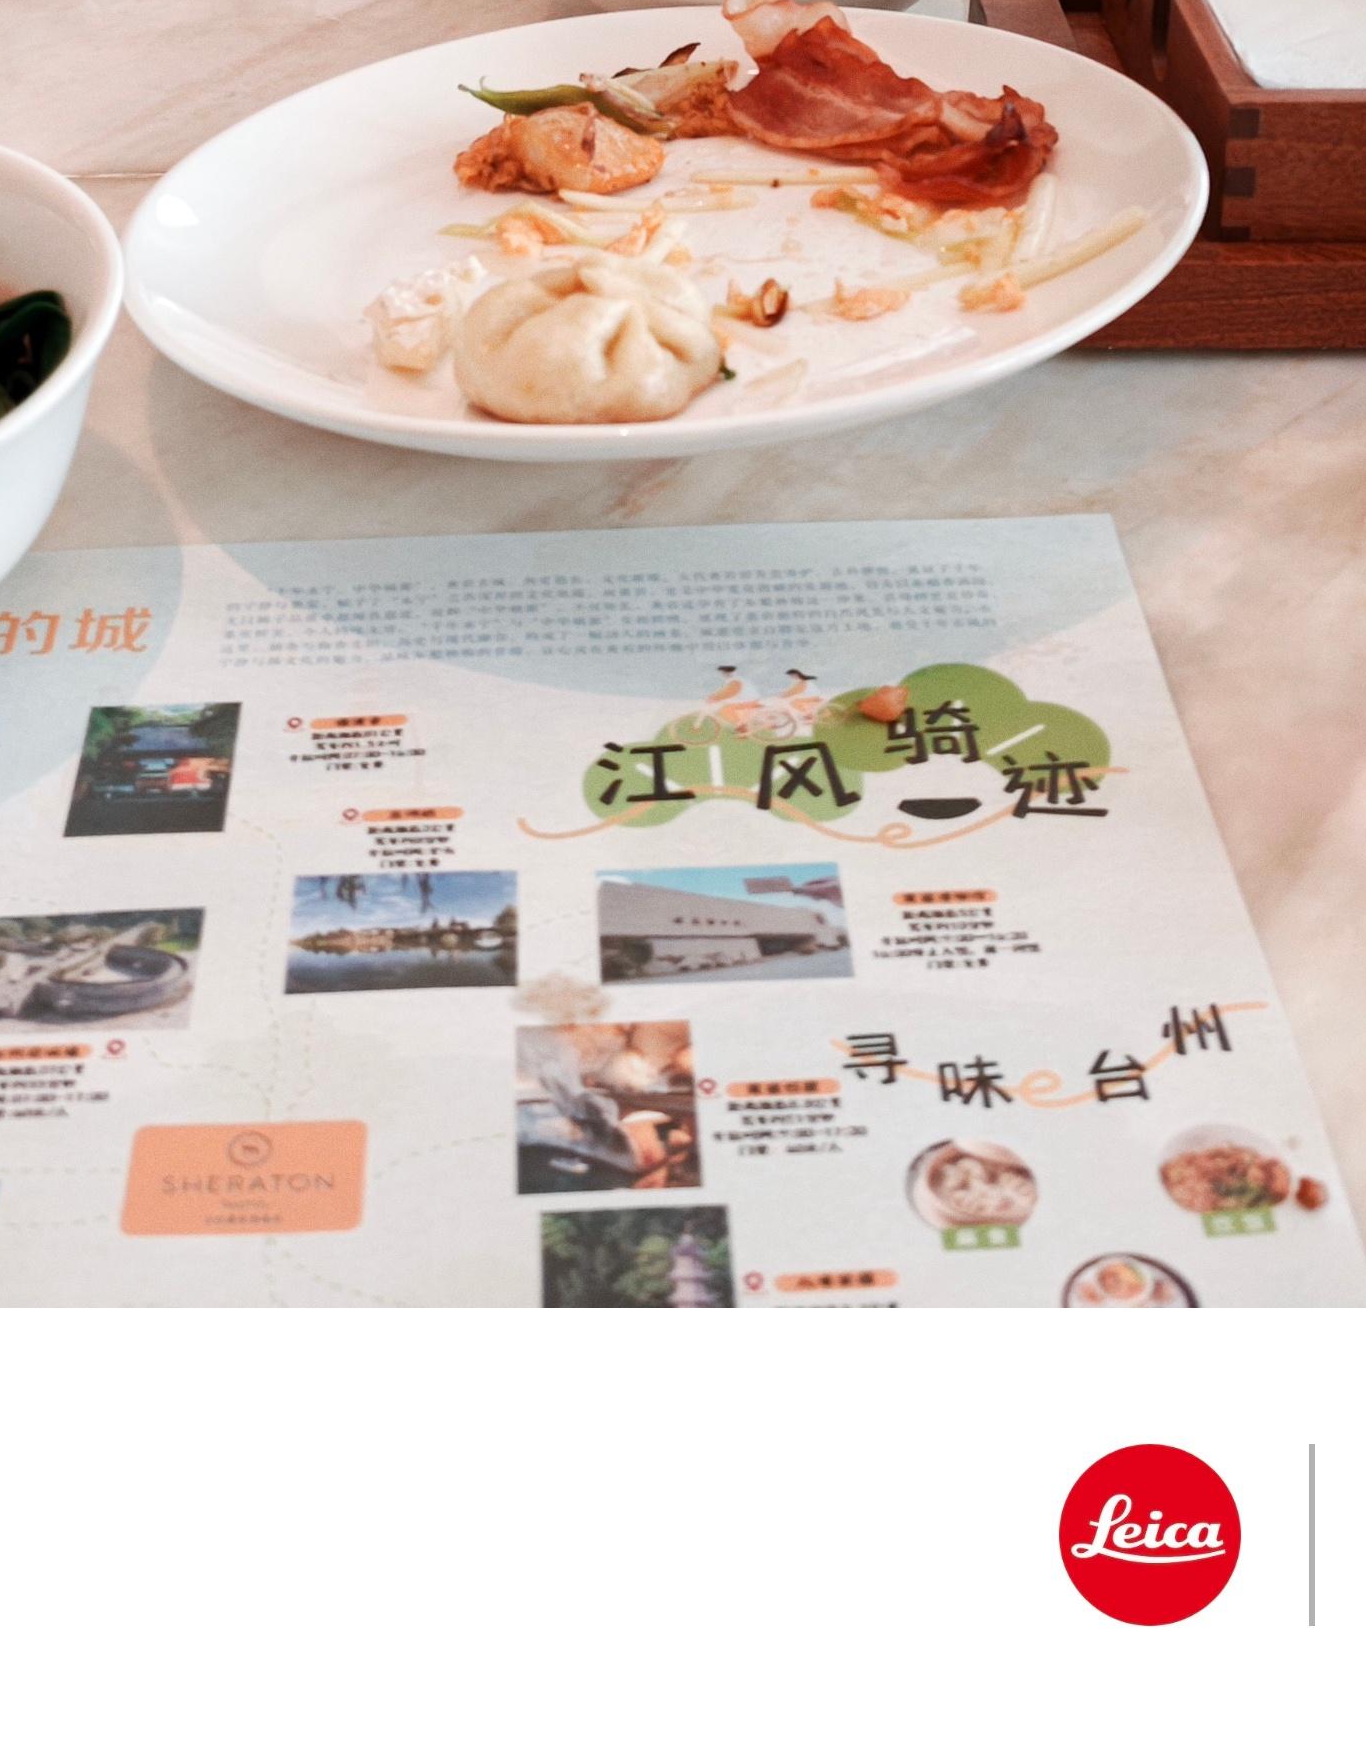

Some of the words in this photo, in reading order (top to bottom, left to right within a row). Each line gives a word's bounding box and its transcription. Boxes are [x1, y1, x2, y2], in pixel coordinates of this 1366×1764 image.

[597, 699, 1110, 819] 江风骑迹
[842, 1002, 1233, 1109] 寻味台州
[160, 1173, 335, 1195] SHERATON
